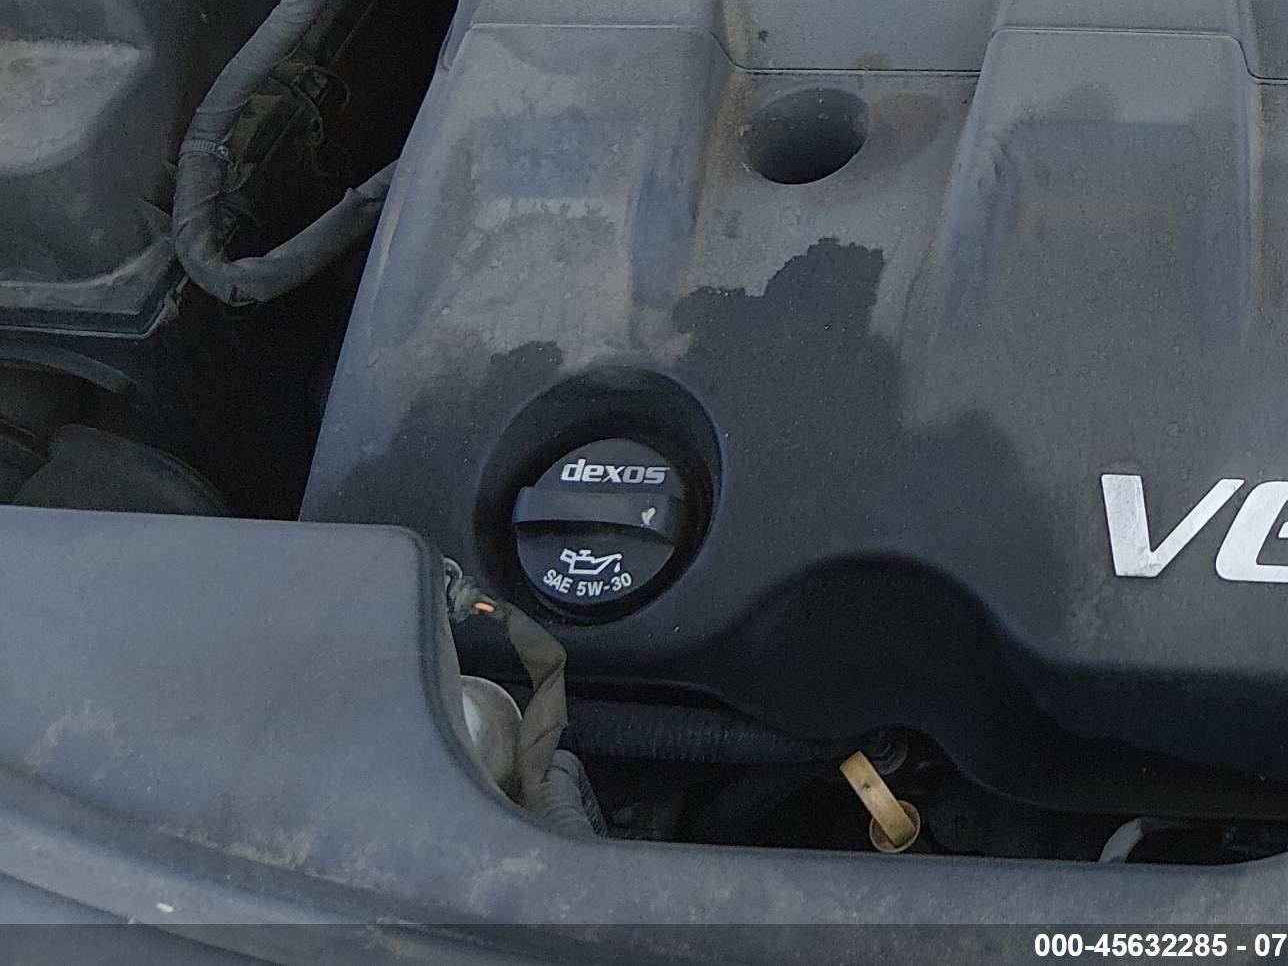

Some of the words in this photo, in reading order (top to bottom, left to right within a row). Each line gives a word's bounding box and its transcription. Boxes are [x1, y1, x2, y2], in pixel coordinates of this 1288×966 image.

[561, 458, 667, 484] dexos
[543, 569, 573, 594] SAE
[576, 572, 632, 596] 5W-30
